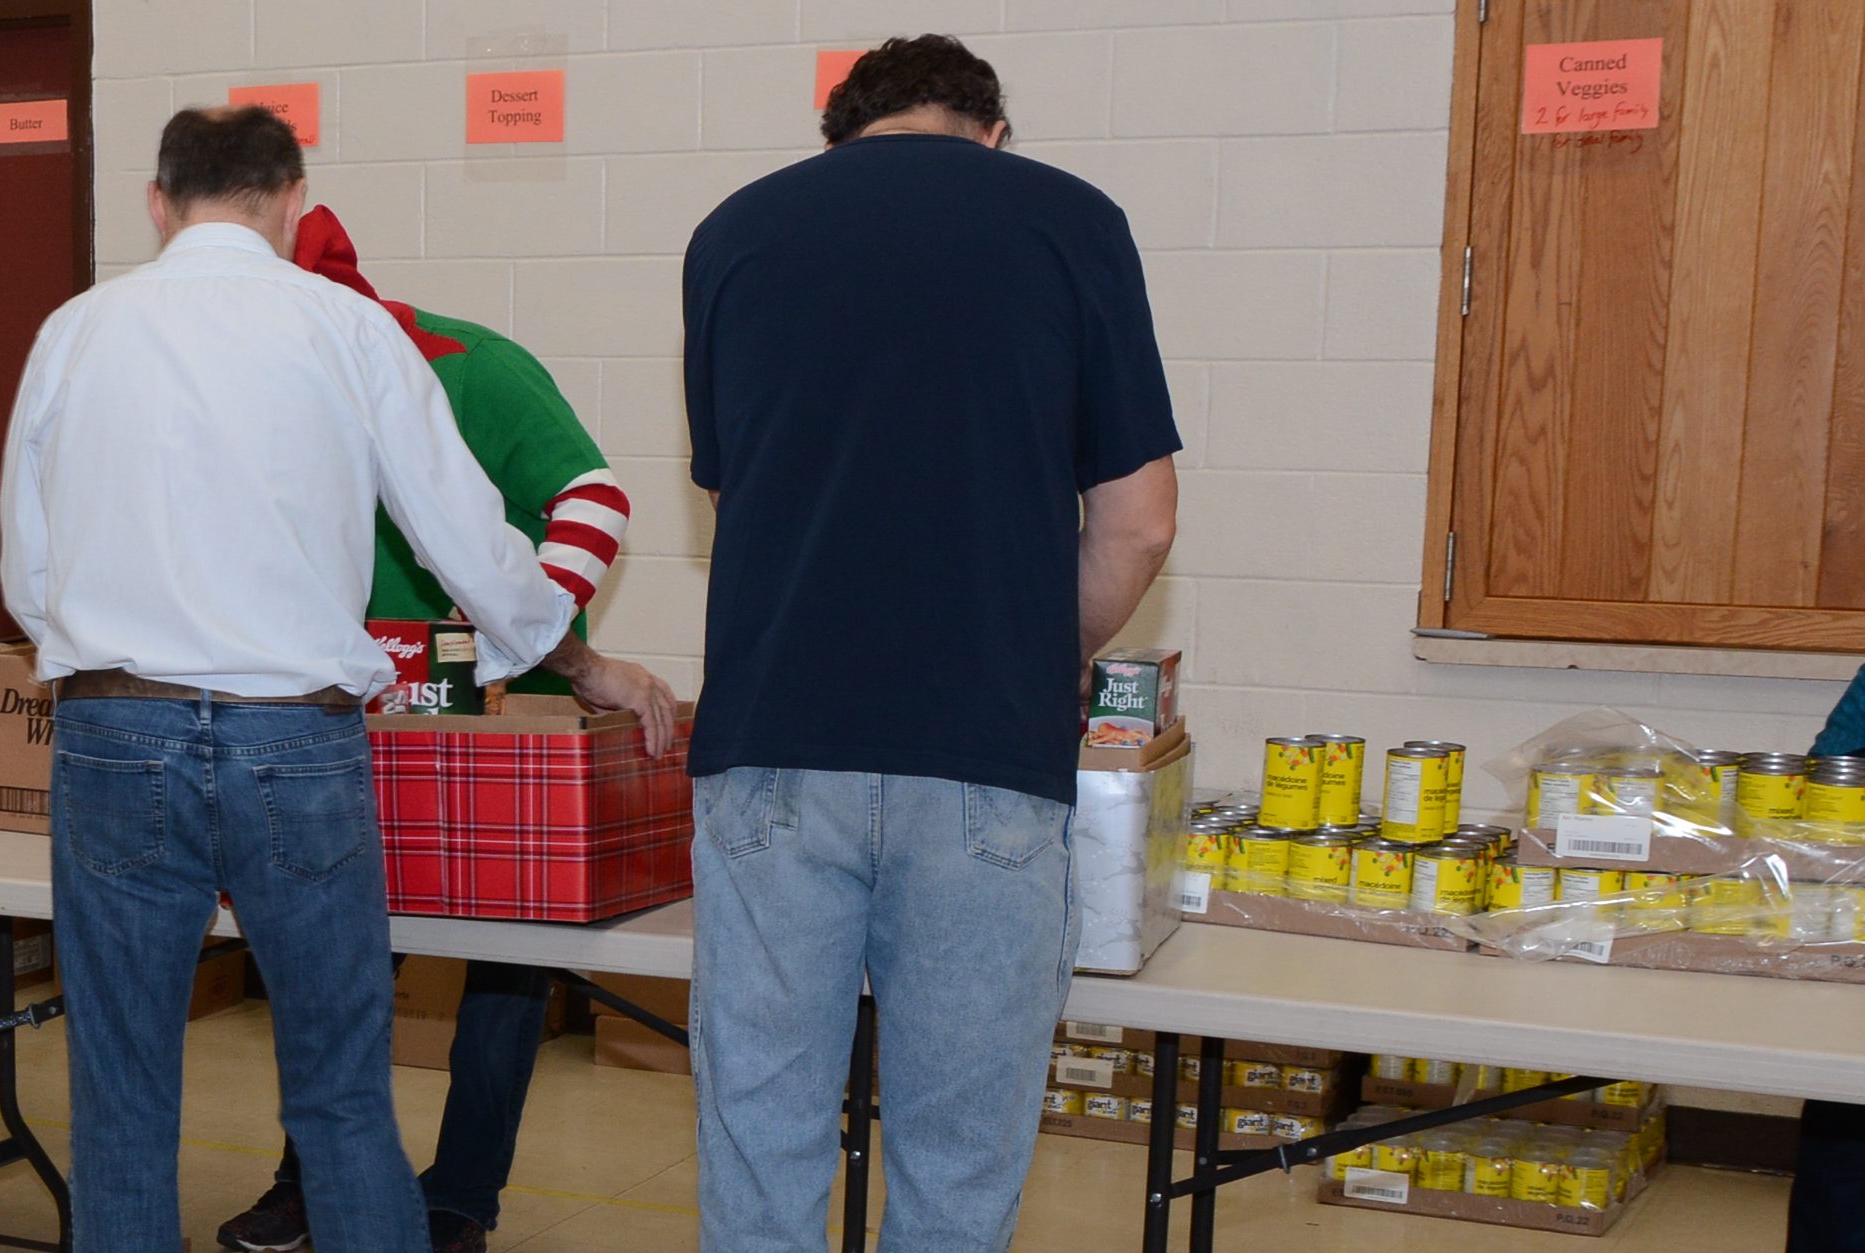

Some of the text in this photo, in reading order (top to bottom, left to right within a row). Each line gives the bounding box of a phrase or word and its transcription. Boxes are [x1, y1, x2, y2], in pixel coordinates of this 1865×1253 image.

[1559, 54, 1627, 72] Canned
[490, 89, 539, 103] Dessert
[1556, 79, 1628, 100] Veggies
[9, 118, 43, 131] Butter
[488, 109, 542, 126] Topping
[1102, 677, 1140, 693] Just
[0, 687, 55, 717] Drea
[1097, 692, 1146, 711] Right
